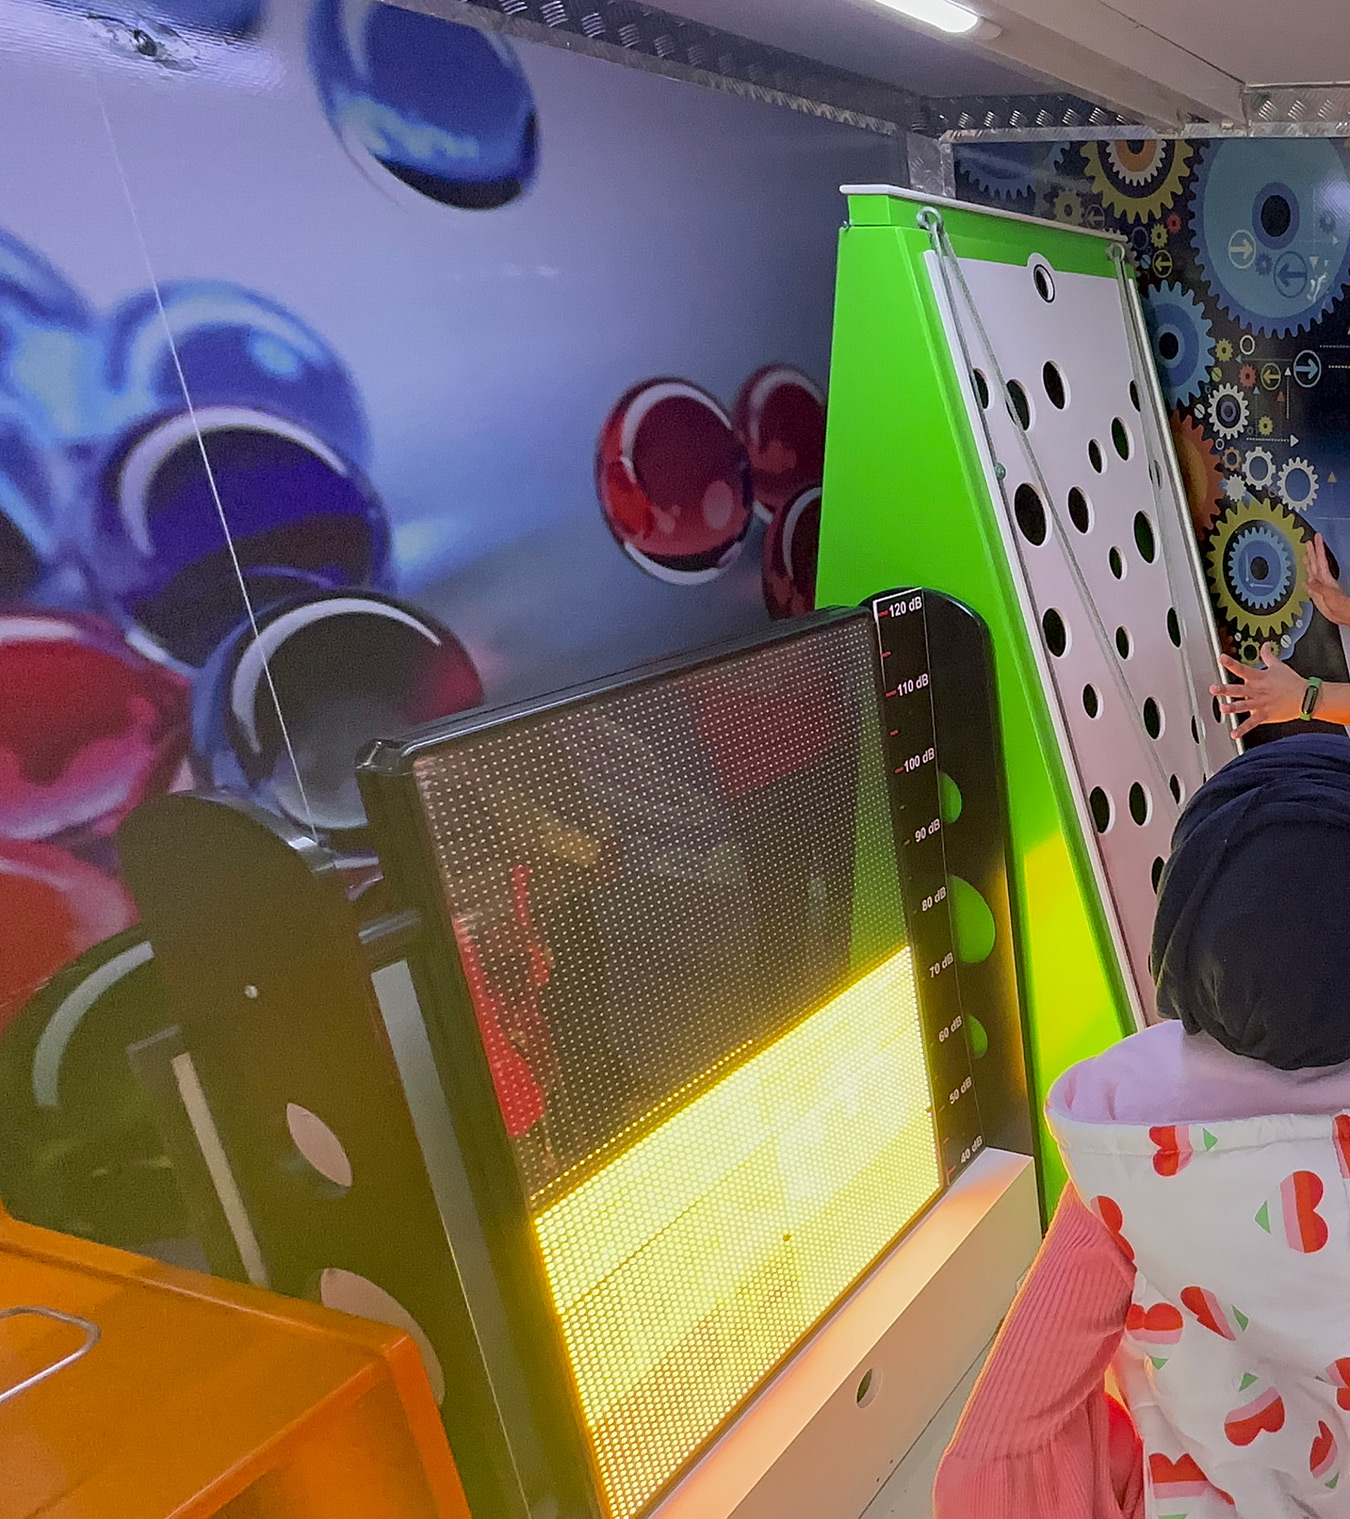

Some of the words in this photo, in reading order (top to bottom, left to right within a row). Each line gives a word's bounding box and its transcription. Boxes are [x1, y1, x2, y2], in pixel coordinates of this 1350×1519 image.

[889, 600, 907, 618] 120
[908, 596, 923, 612] dB
[897, 679, 914, 697] 110
[915, 673, 929, 690] dB
[903, 754, 921, 773] 100
[922, 747, 935, 764] dB
[914, 826, 927, 843] 90
[928, 818, 941, 835] dB
[921, 895, 933, 912] 80
[934, 886, 947, 903] dB
[929, 962, 941, 979] 70
[941, 952, 954, 969] dB
[938, 1026, 950, 1043] 60
[950, 1015, 963, 1033] dB
[949, 1088, 960, 1105] 50
[960, 1075, 973, 1094] dB
[960, 1148, 971, 1164] 40
[971, 1135, 983, 1153] dB
